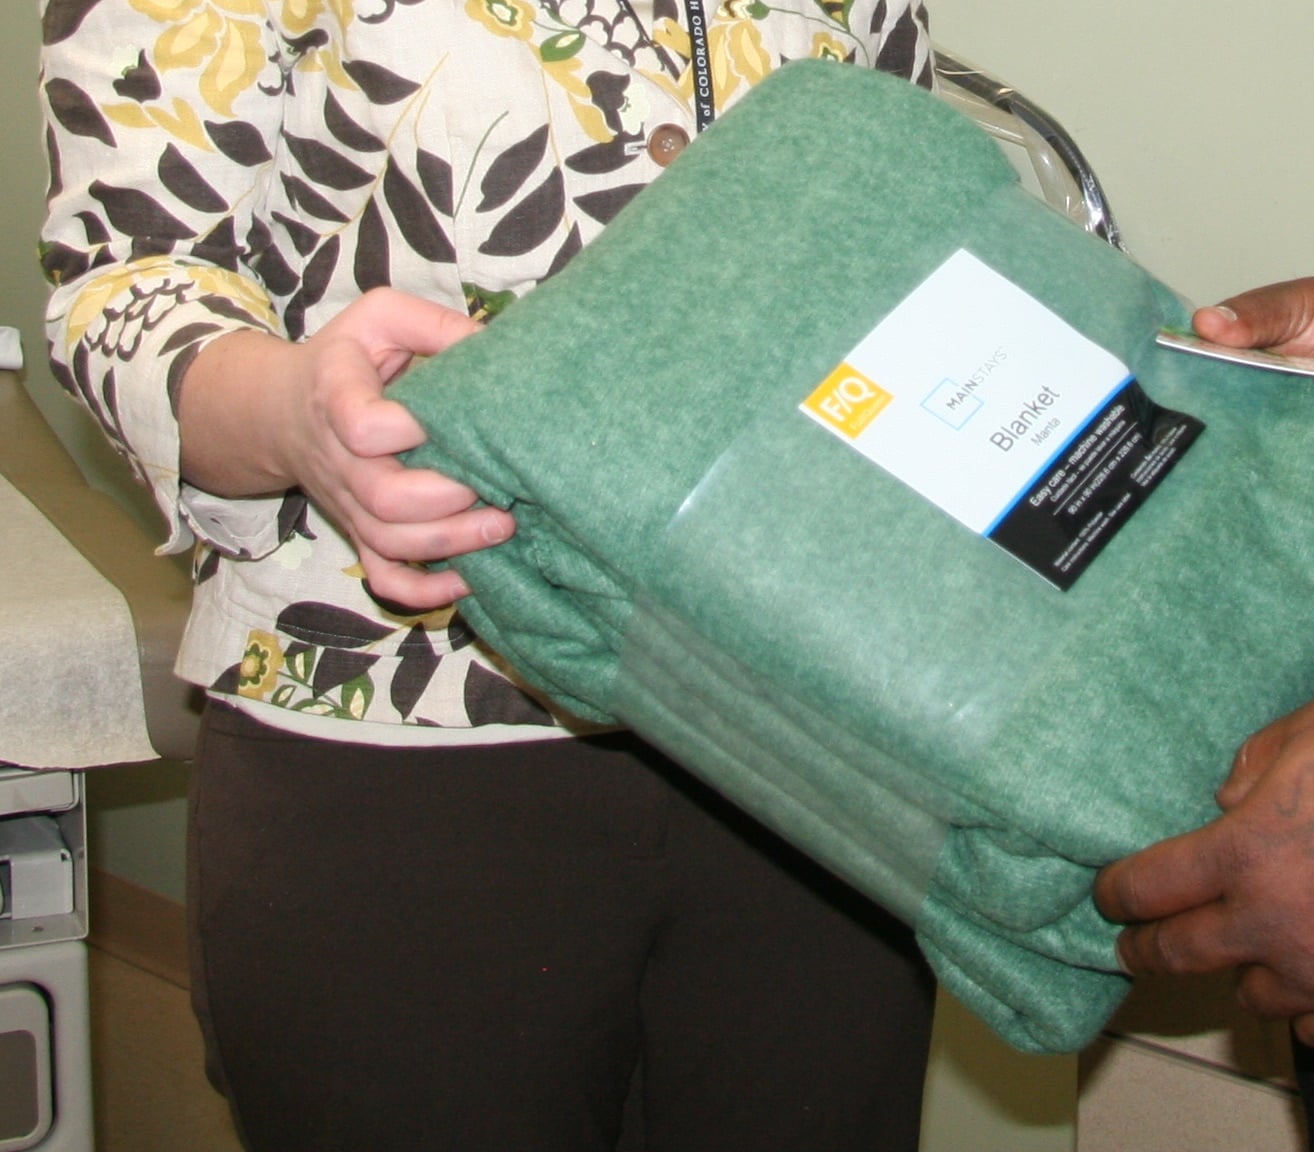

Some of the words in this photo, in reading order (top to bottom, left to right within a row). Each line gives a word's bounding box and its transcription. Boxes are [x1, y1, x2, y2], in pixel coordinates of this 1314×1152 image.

[692, 15, 709, 98] COLORADO
[701, 103, 711, 117] of
[820, 376, 875, 421] F/Q
[946, 347, 1007, 410] MAINSTAYS
[989, 385, 1060, 451] Blanket
[1031, 417, 1060, 444] Manta
[1029, 486, 1050, 507] Easy
[1048, 469, 1066, 487] care
[1068, 434, 1097, 464] machine
[1094, 405, 1125, 434] washable
[1068, 505, 1078, 514] 90
